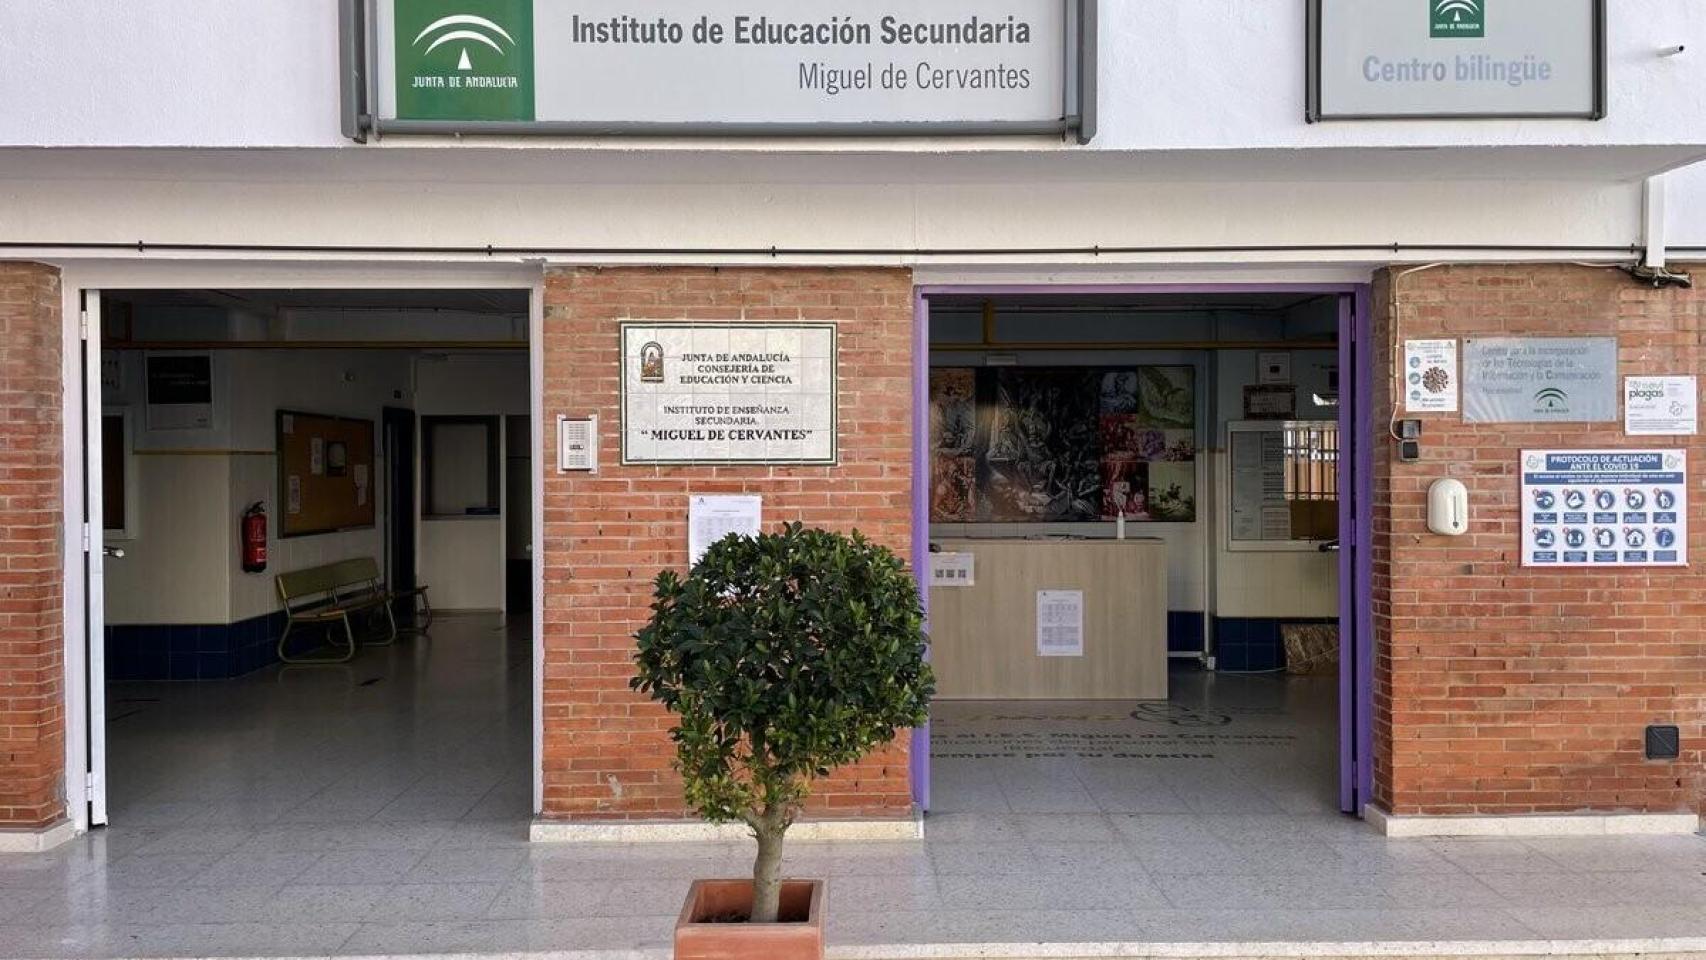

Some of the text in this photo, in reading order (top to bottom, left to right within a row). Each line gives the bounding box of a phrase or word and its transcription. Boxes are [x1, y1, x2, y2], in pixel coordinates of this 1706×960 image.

[572, 15, 1030, 44] Instituto de Educación Secundaria
[1362, 55, 1552, 87] Centro bilingüe
[412, 76, 445, 88] JUNTA
[449, 76, 461, 88] DE
[799, 62, 1030, 95] Miguel de Cervantes
[682, 350, 791, 362] JUNTA DE ANDALUCÍA
[697, 363, 775, 373] CONSEJERÍA DE
[680, 374, 792, 384] EDUCACIÓN Y CIENCIA
[1629, 388, 1664, 401] plagas
[663, 404, 790, 415] INSTITUTO DE ENSEÑANZA
[708, 429, 726, 440] DE
[1550, 454, 1659, 463] PROTOCOLO DE ACTUACIÓN
[1570, 463, 1591, 471] ANTE
[1592, 463, 1602, 471] EL
[1603, 463, 1628, 471] COVID
